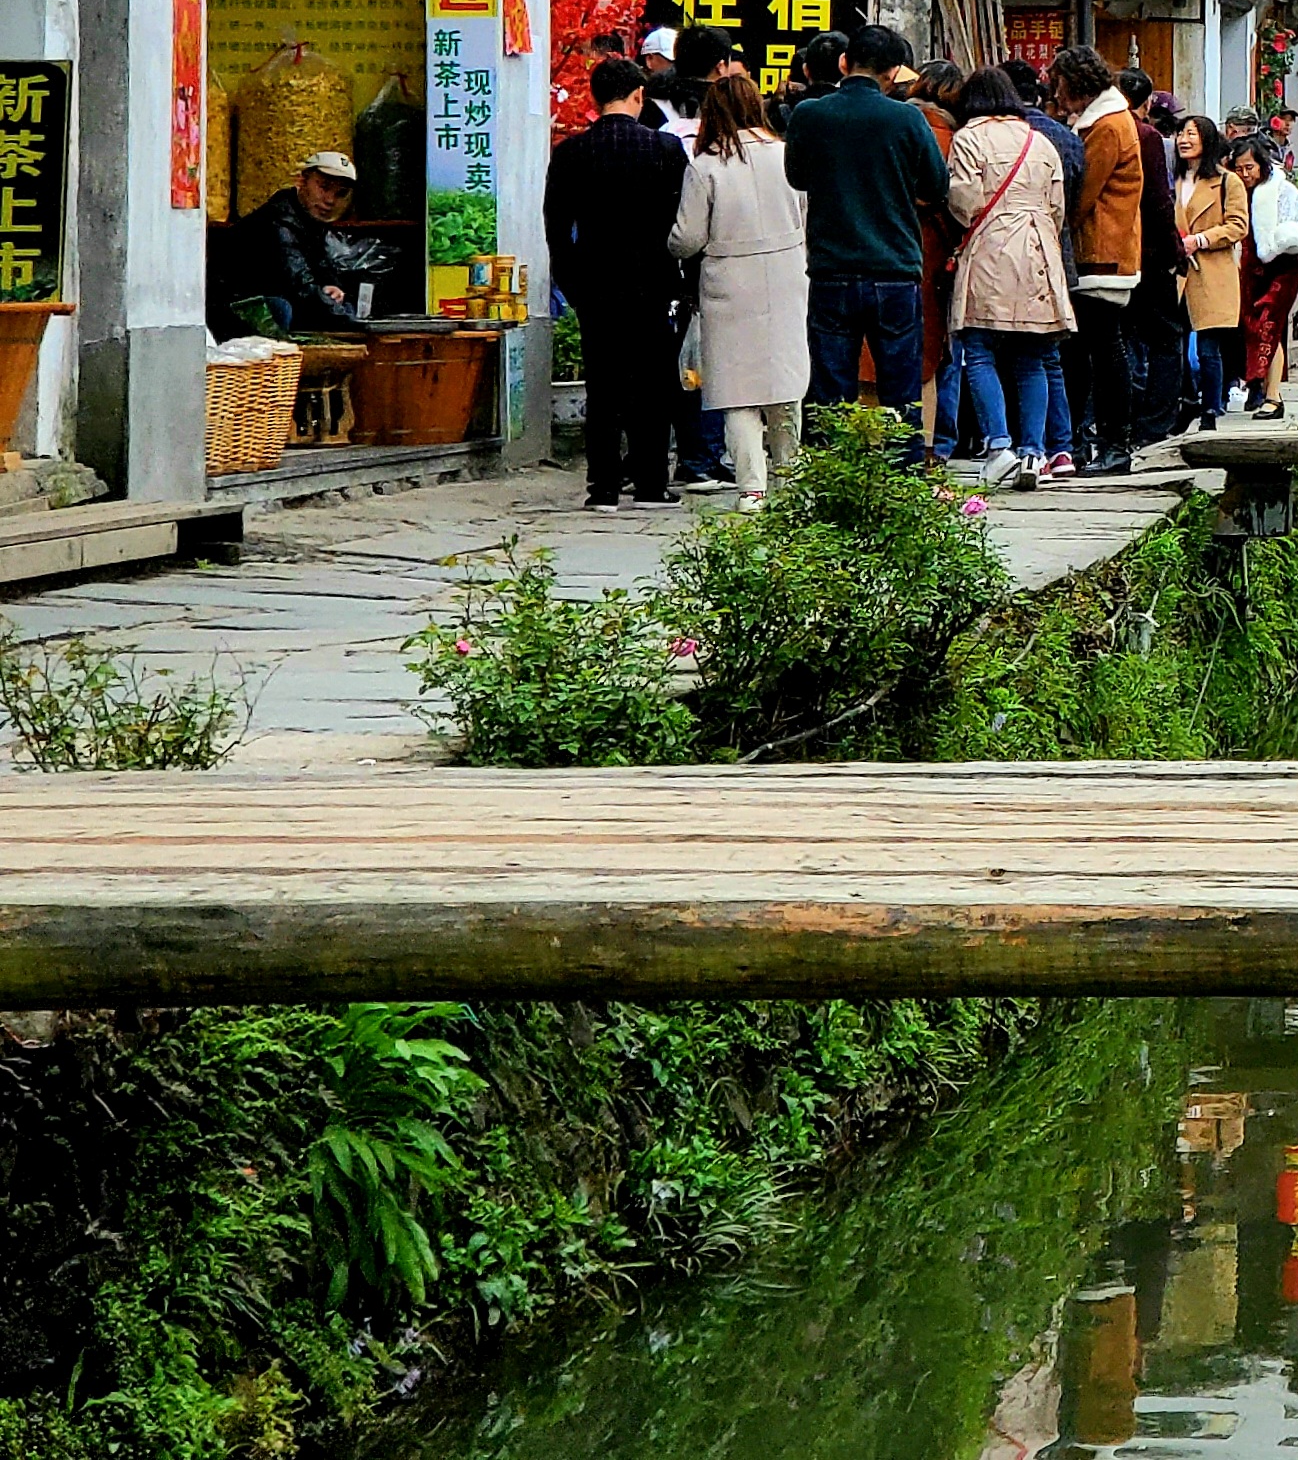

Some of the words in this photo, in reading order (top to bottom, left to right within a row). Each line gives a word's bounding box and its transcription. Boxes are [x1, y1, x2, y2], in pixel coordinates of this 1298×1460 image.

[433, 29, 462, 151] 新茶上市
[1007, 43, 1064, 60] 黄花梨
[0, 73, 50, 291] 新茶上市
[464, 69, 492, 192] 现炒现卖
